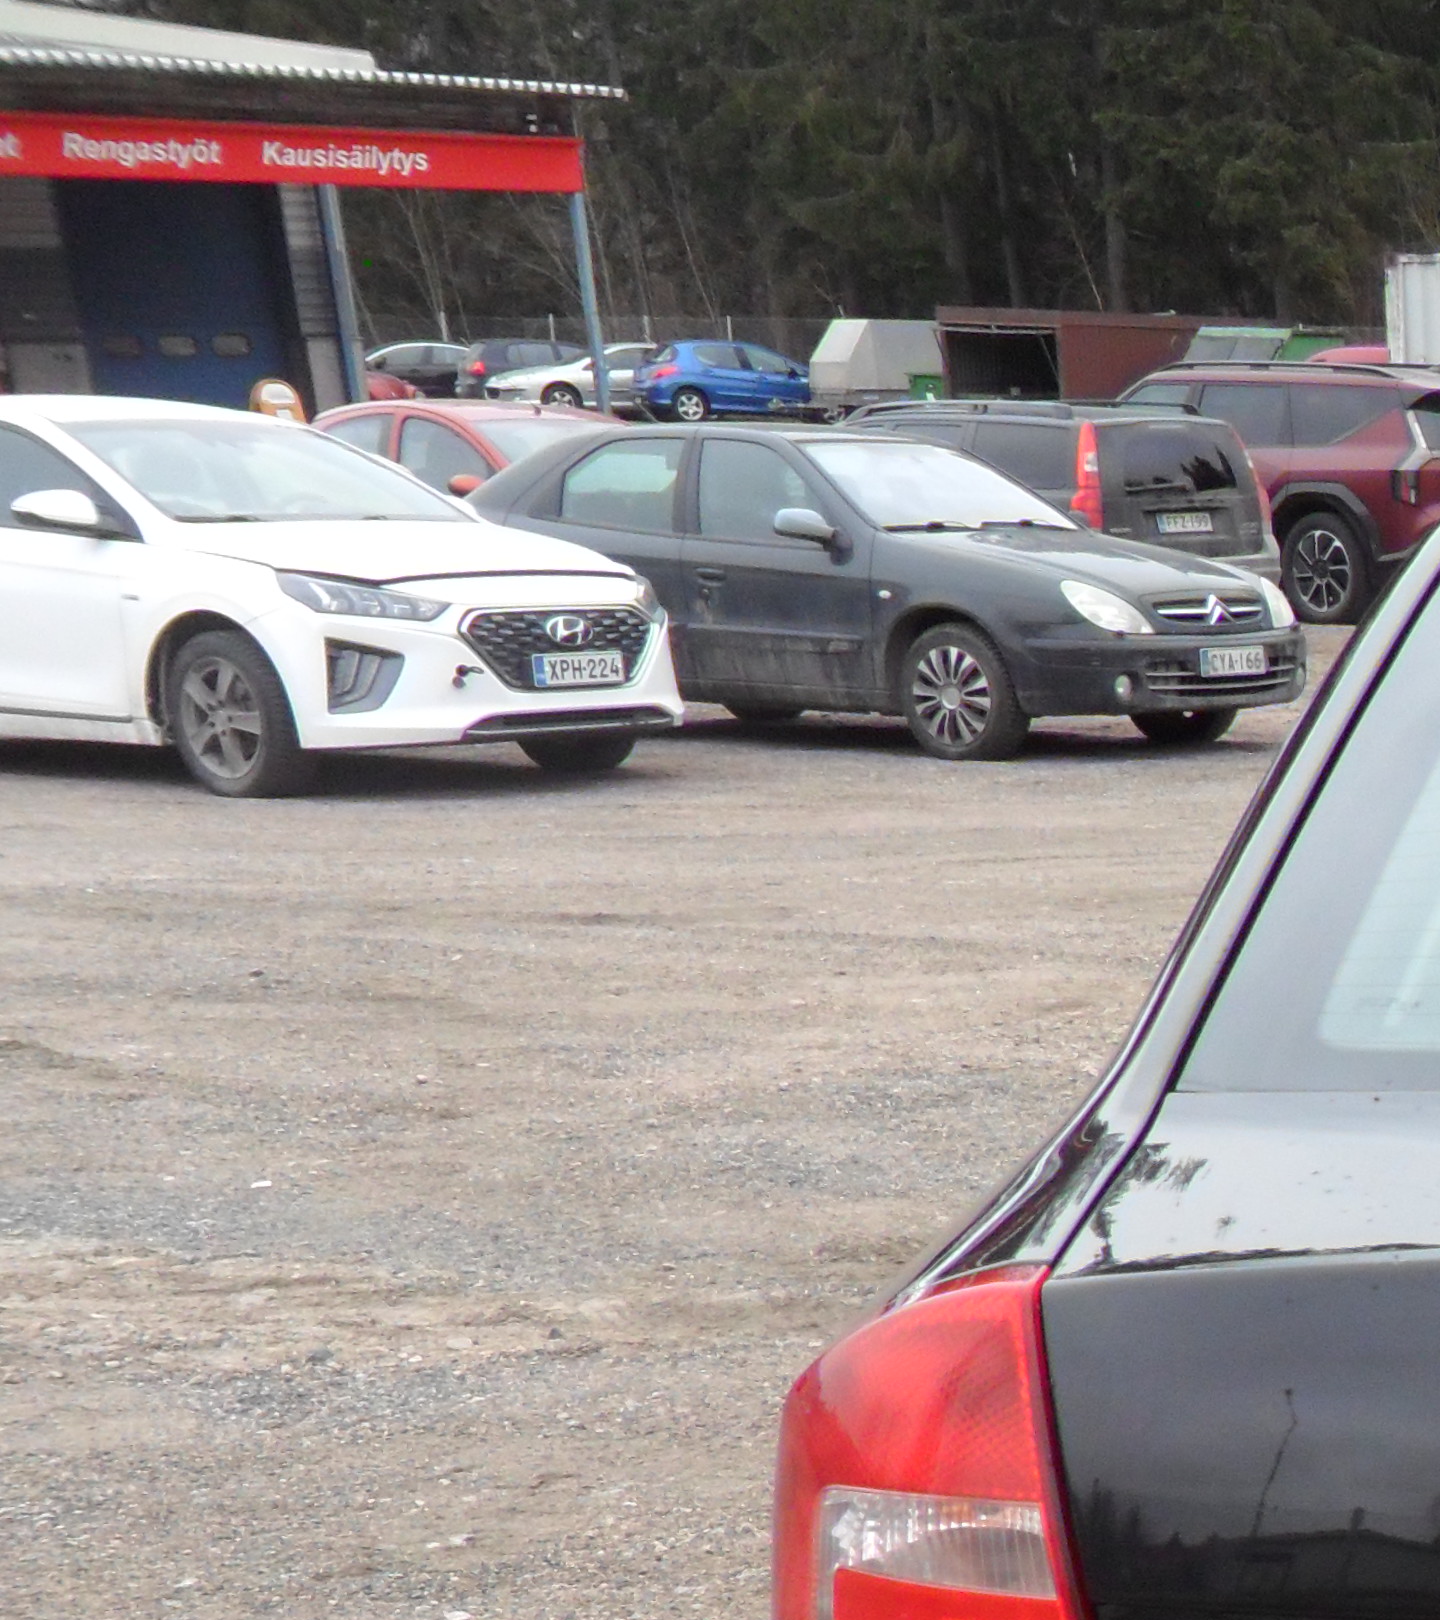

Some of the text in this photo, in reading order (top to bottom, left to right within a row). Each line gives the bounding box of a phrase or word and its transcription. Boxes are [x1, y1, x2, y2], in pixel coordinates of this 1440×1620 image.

[62, 131, 222, 169] Rengastyöt
[262, 140, 429, 176] Kausisäilytys
[548, 657, 620, 681] XPH-224
